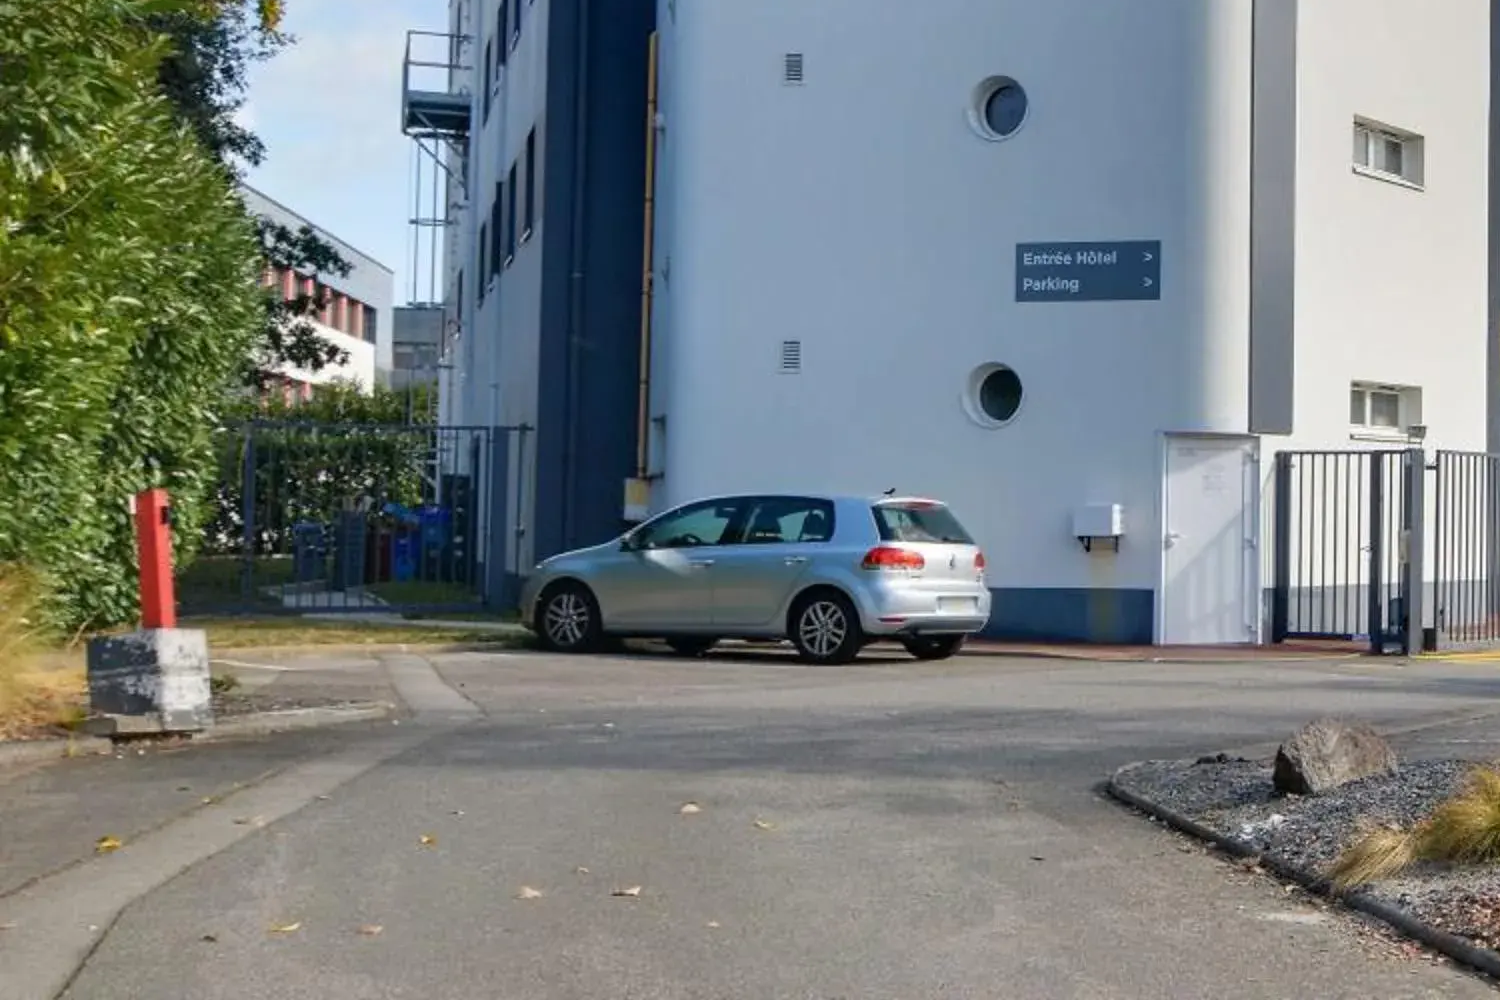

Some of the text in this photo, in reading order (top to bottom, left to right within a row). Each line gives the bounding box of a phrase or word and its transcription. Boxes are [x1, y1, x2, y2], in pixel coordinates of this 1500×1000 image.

[1023, 250, 1117, 265] Entrée Hôtel
[1023, 276, 1079, 293] Parking
